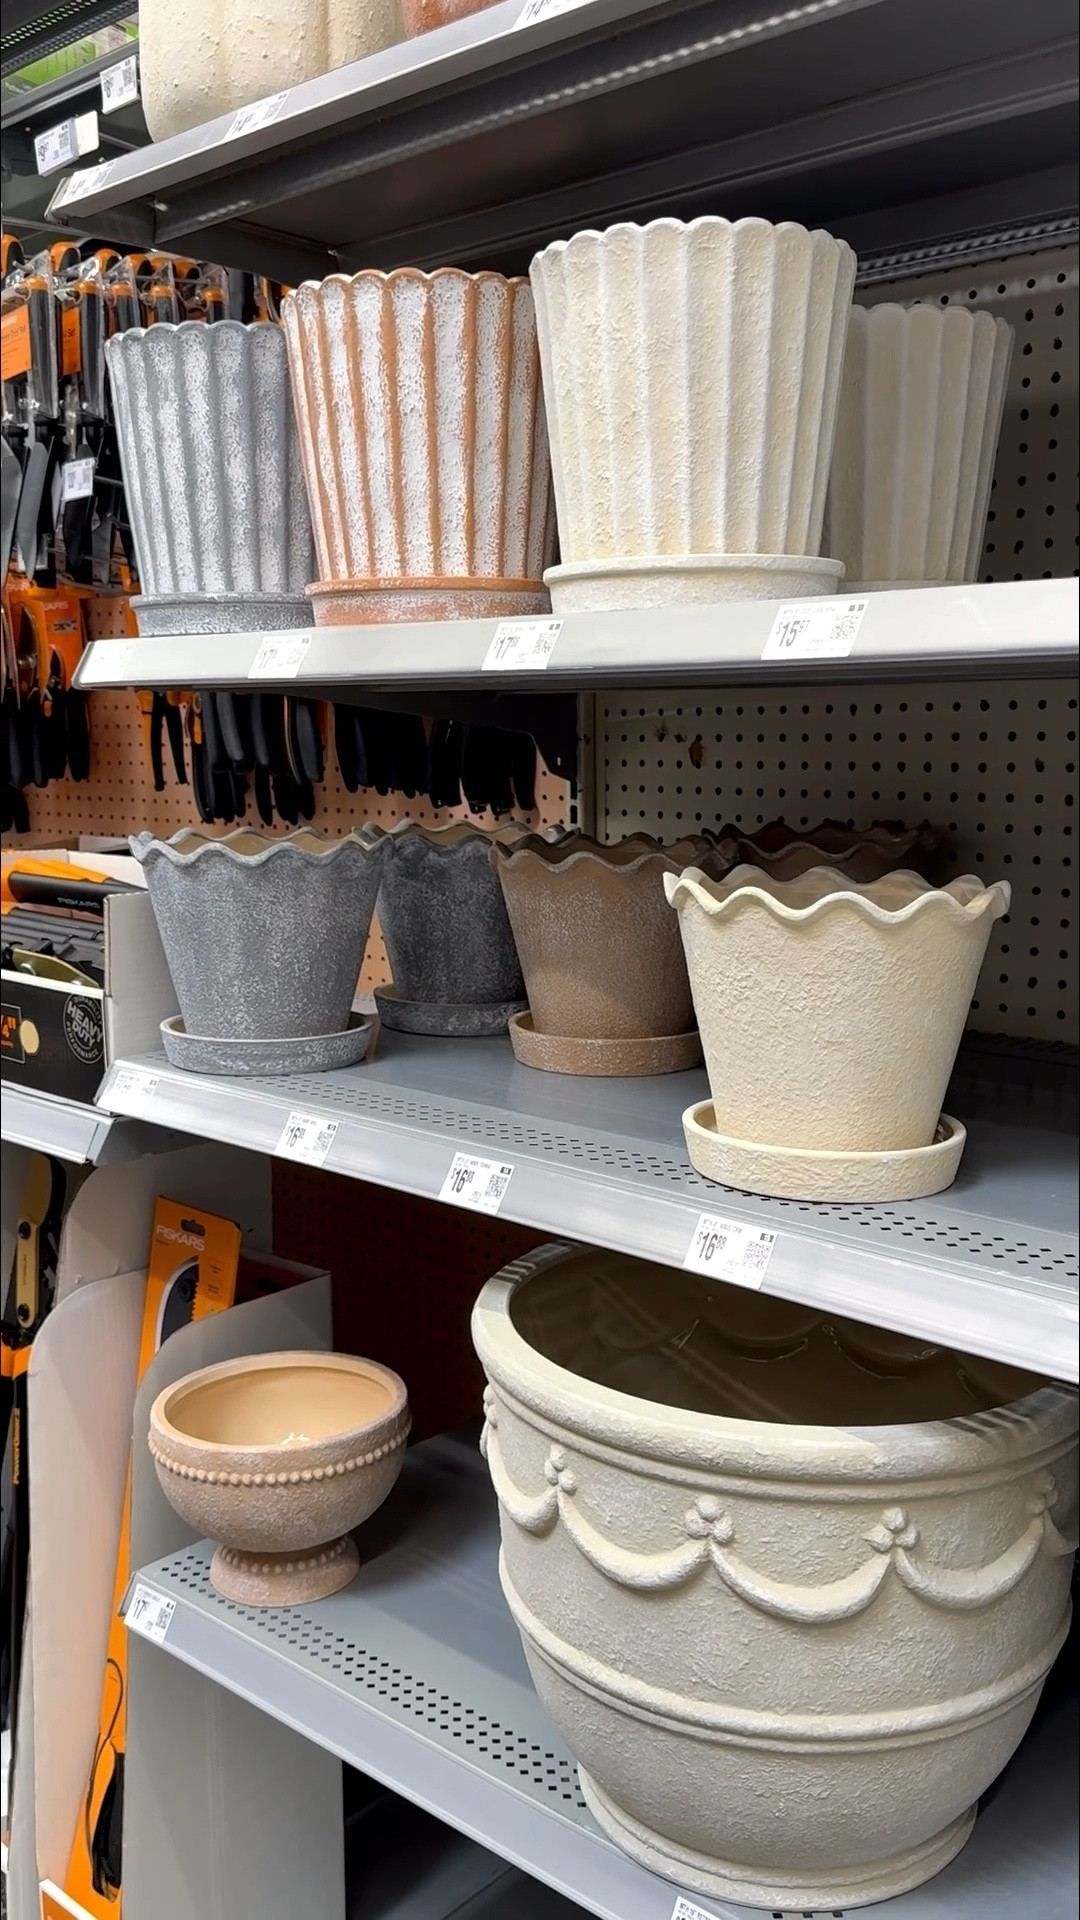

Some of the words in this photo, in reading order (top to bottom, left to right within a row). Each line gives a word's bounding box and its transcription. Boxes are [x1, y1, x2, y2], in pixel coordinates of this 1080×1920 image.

[66, 1001, 104, 1043] HEAVY
[72, 1019, 96, 1047] DUTY
[156, 1224, 206, 1252] FISKARS
